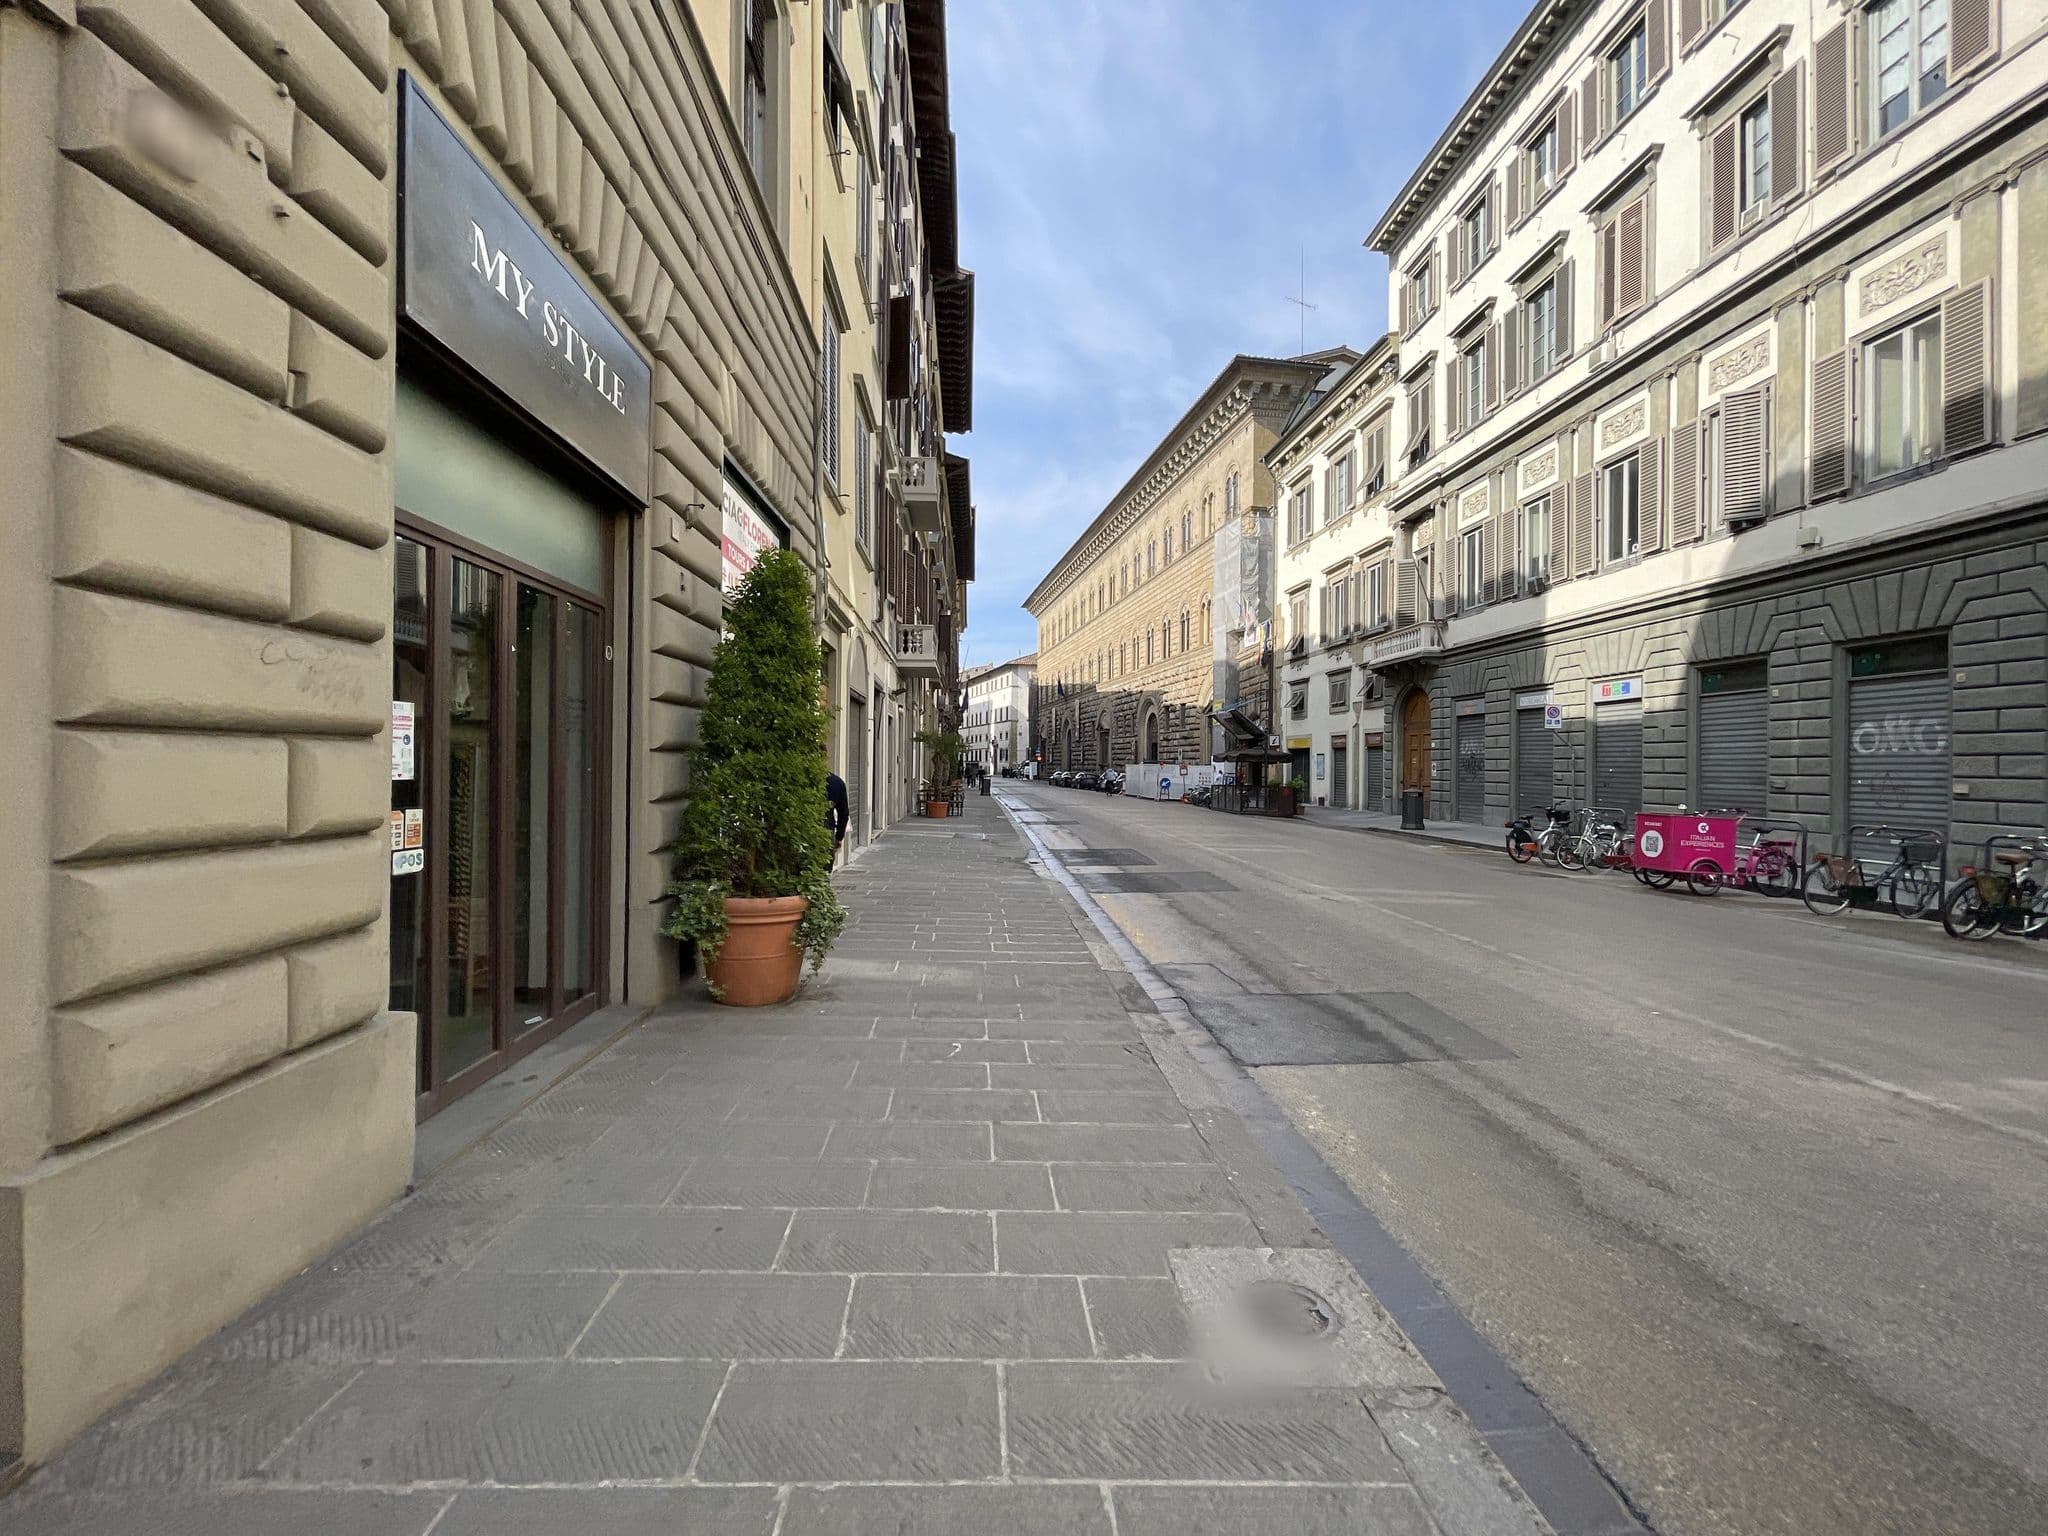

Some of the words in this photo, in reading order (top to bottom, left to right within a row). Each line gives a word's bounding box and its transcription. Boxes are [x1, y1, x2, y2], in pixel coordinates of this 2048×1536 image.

[470, 219, 535, 320] MY
[543, 300, 626, 416] STYLE
[1680, 839, 1725, 849] EXPERIENCES
[1690, 834, 1716, 842] ITALIAN
[399, 852, 423, 869] POS
